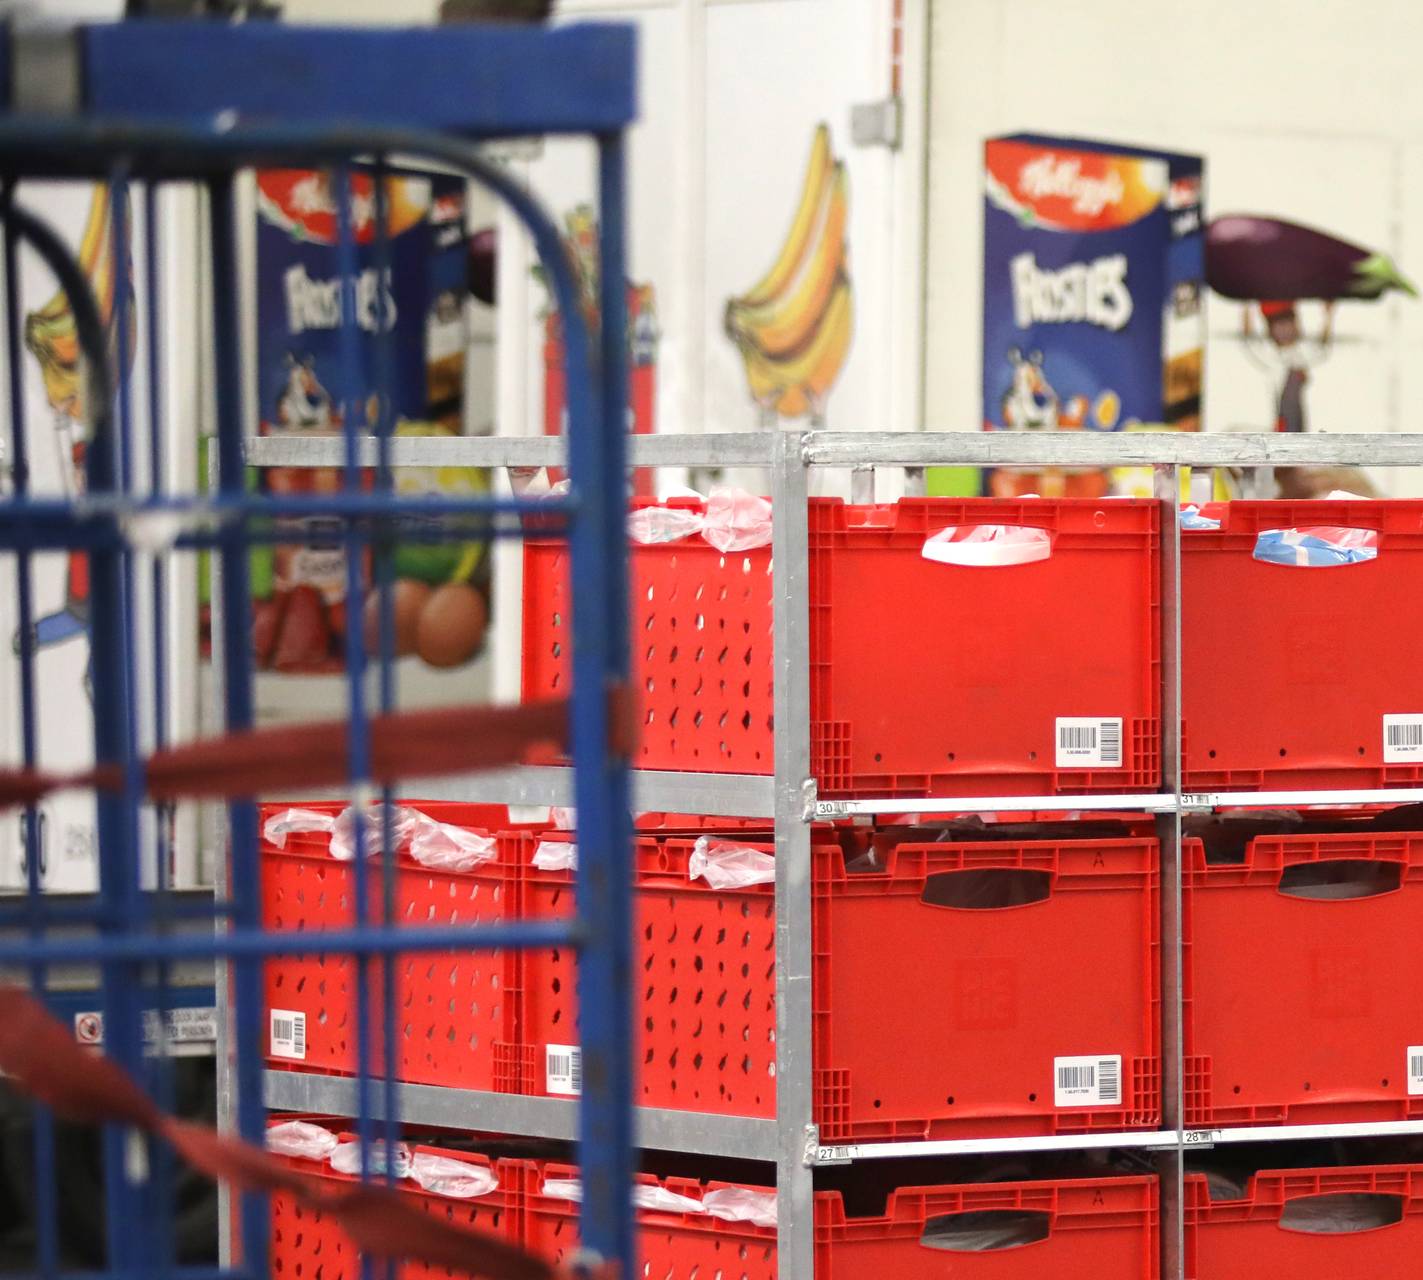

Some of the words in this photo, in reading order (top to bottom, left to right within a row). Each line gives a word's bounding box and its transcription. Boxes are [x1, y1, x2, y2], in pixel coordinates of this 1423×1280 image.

[1182, 795, 1194, 804] 31
[819, 803, 833, 813] 30
[1092, 850, 1105, 868] A
[1186, 1132, 1199, 1142] 28
[820, 1148, 833, 1159] 27
[1092, 1190, 1104, 1206] A
